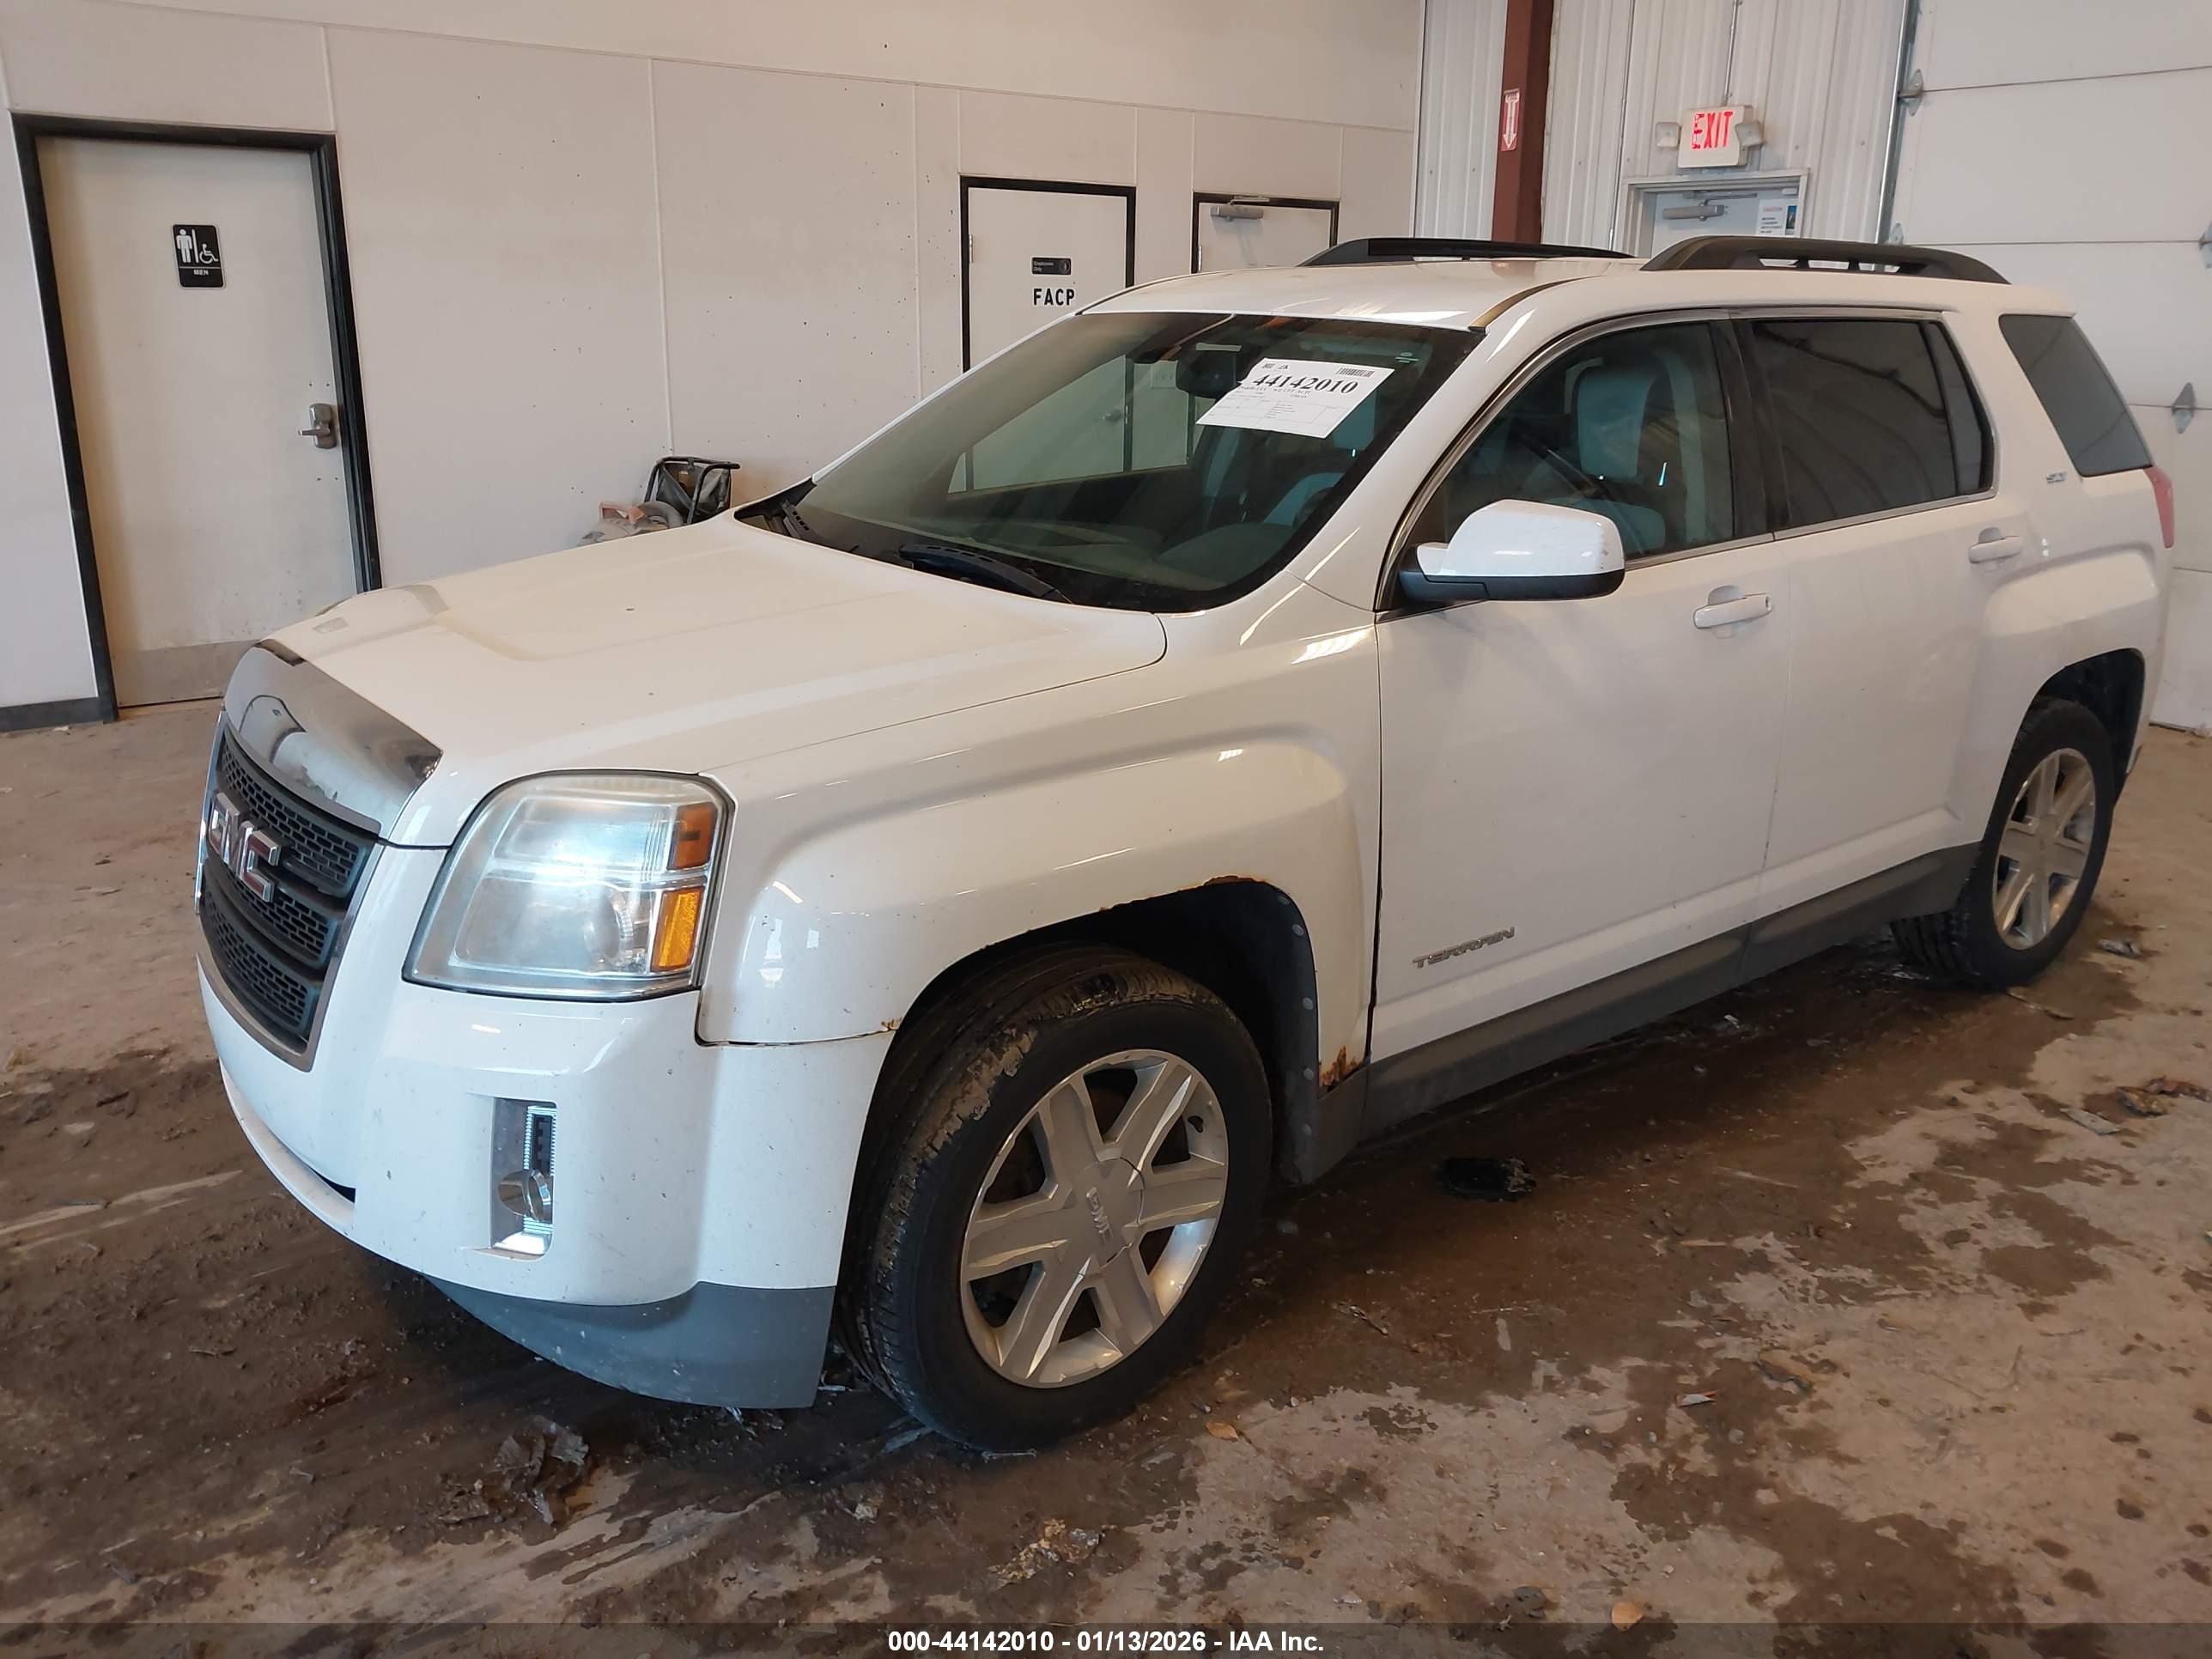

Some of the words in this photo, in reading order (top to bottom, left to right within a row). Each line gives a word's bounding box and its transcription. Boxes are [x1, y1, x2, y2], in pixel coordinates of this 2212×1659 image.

[1691, 110, 1735, 149] EXIT
[1033, 288, 1075, 307] FACP
[1252, 374, 1358, 394] 44142010
[208, 792, 282, 902] GMC
[1413, 927, 1515, 969] TERRAIN
